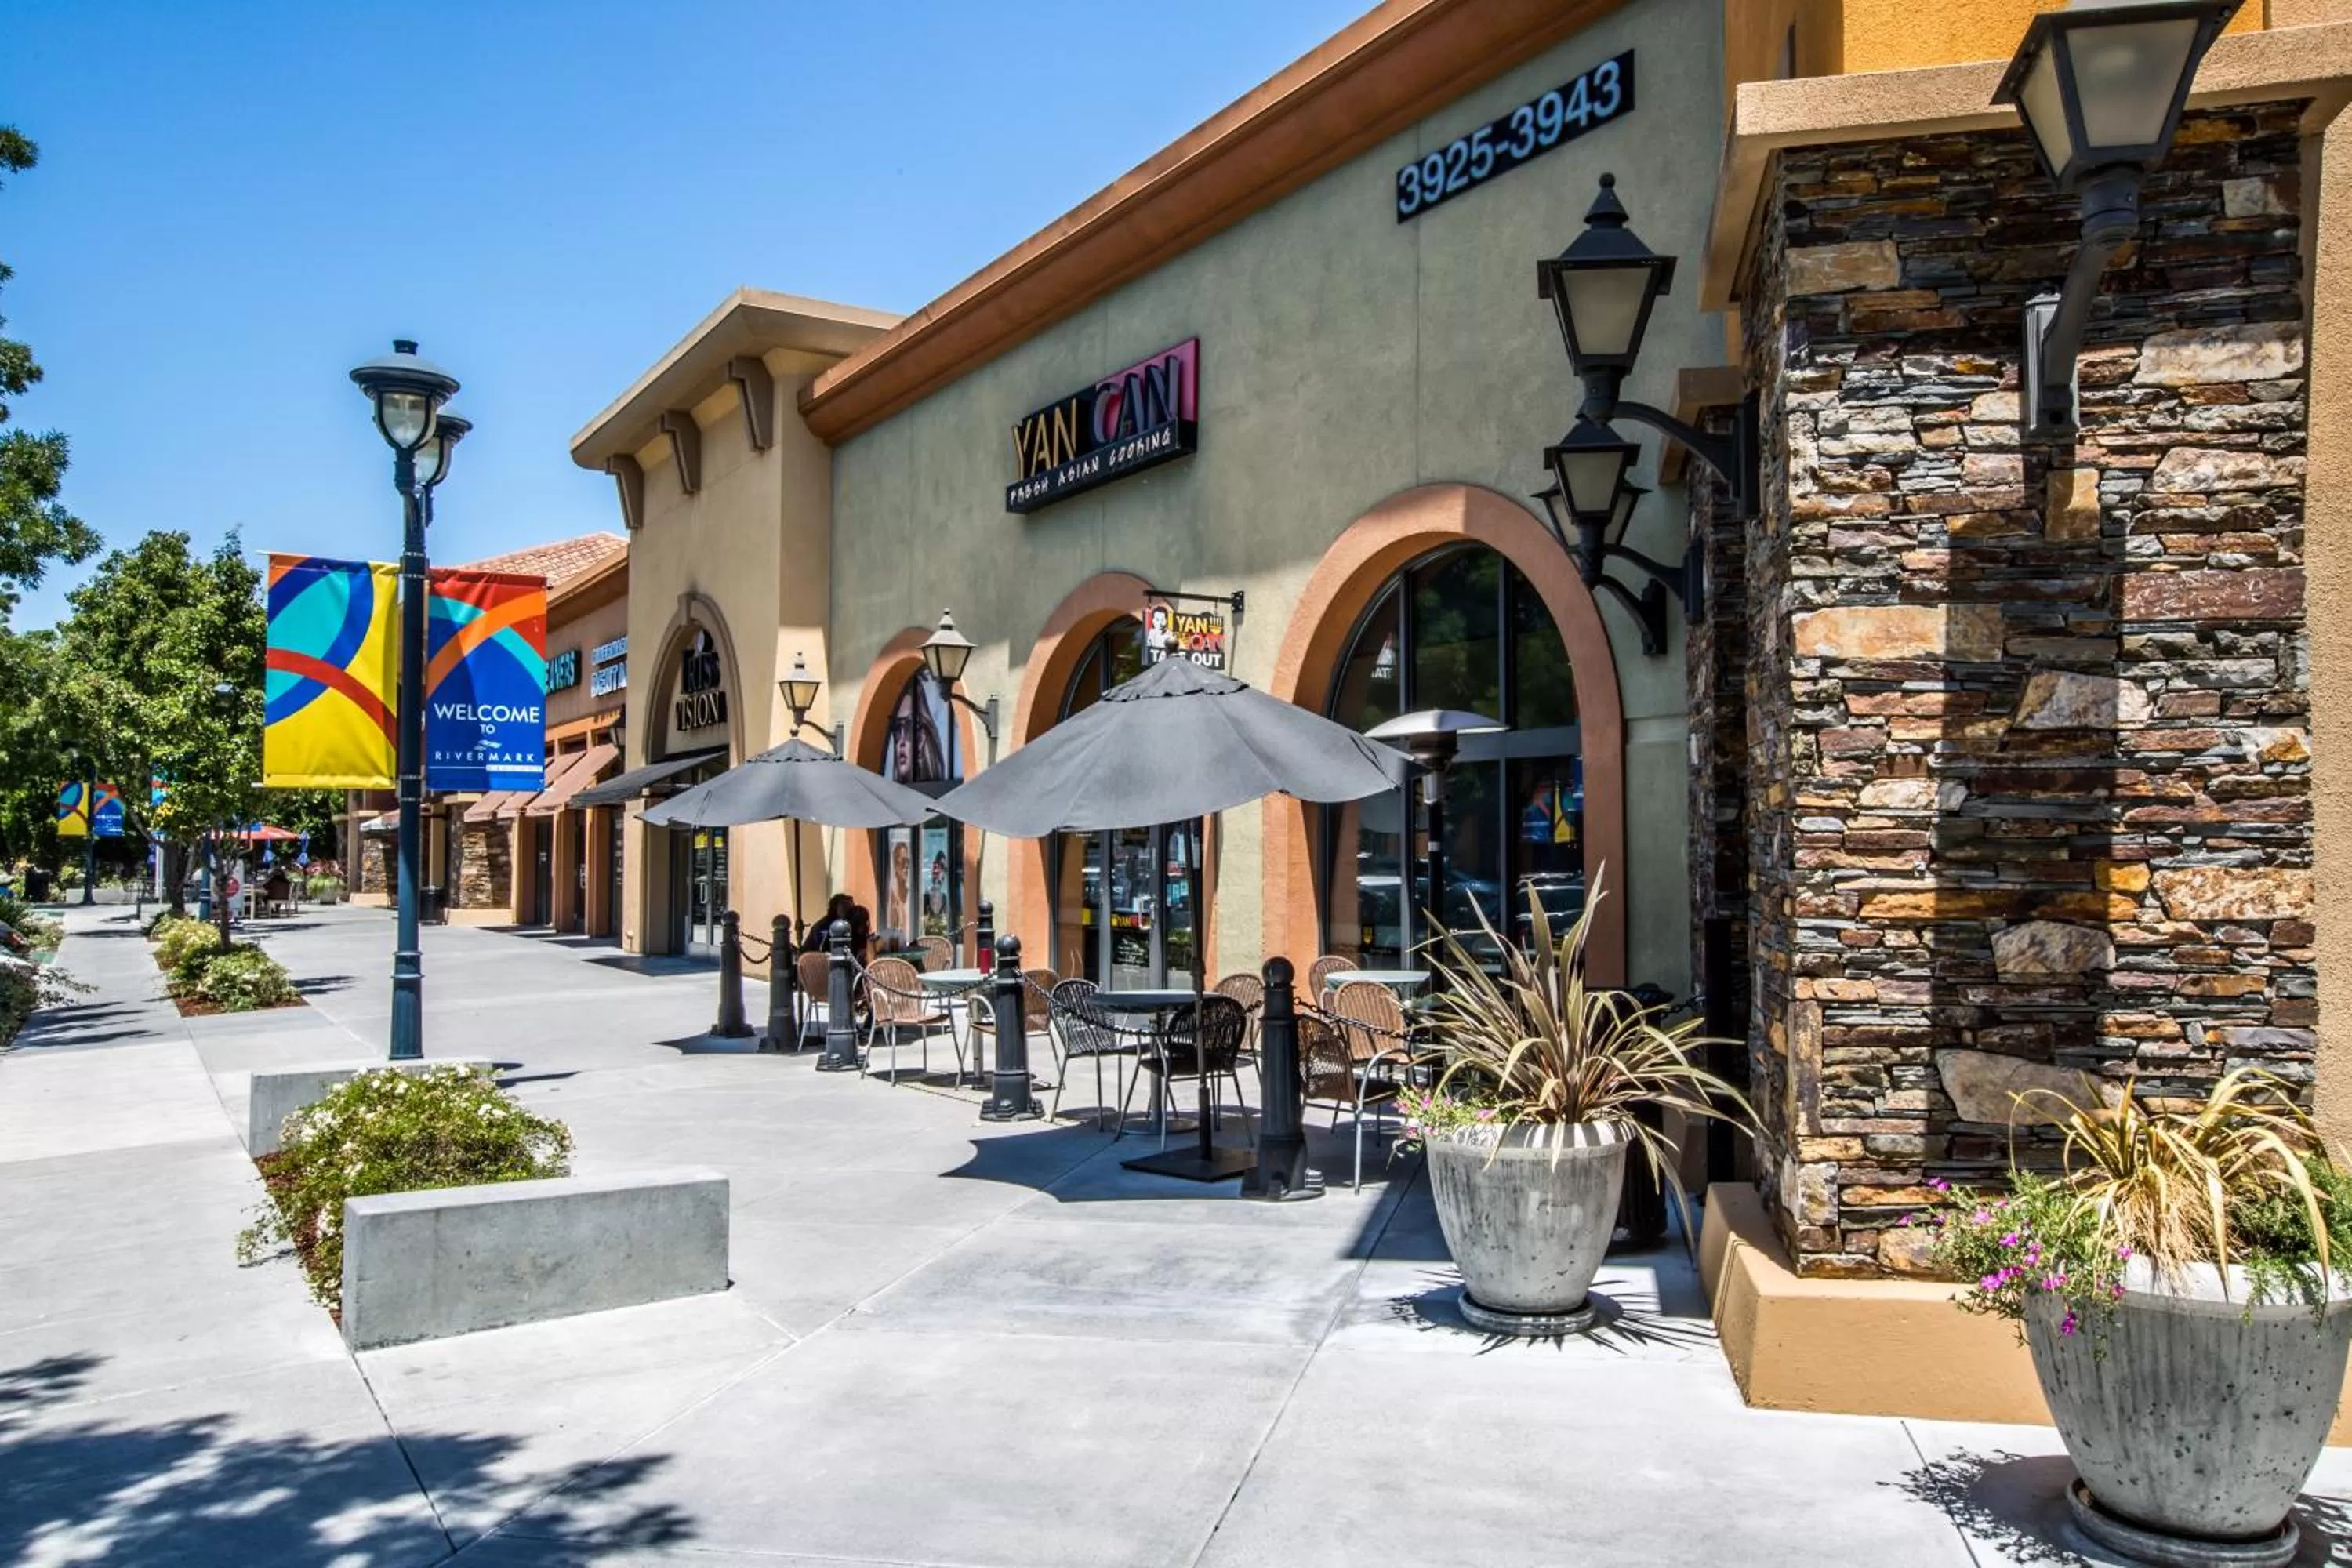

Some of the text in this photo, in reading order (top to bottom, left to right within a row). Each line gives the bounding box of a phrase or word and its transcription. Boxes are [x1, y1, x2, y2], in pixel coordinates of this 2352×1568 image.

[1399, 60, 1621, 213] 3925-3943
[1012, 355, 1179, 480] YAN CAN
[1058, 456, 1100, 487] ASIAN
[1108, 427, 1171, 466] COOKING
[1176, 615, 1209, 634] YAN
[1149, 649, 1222, 667] TA OUT
[434, 703, 540, 724] WELCOME
[479, 724, 496, 735] TO
[434, 750, 535, 762] RIVERMARK
